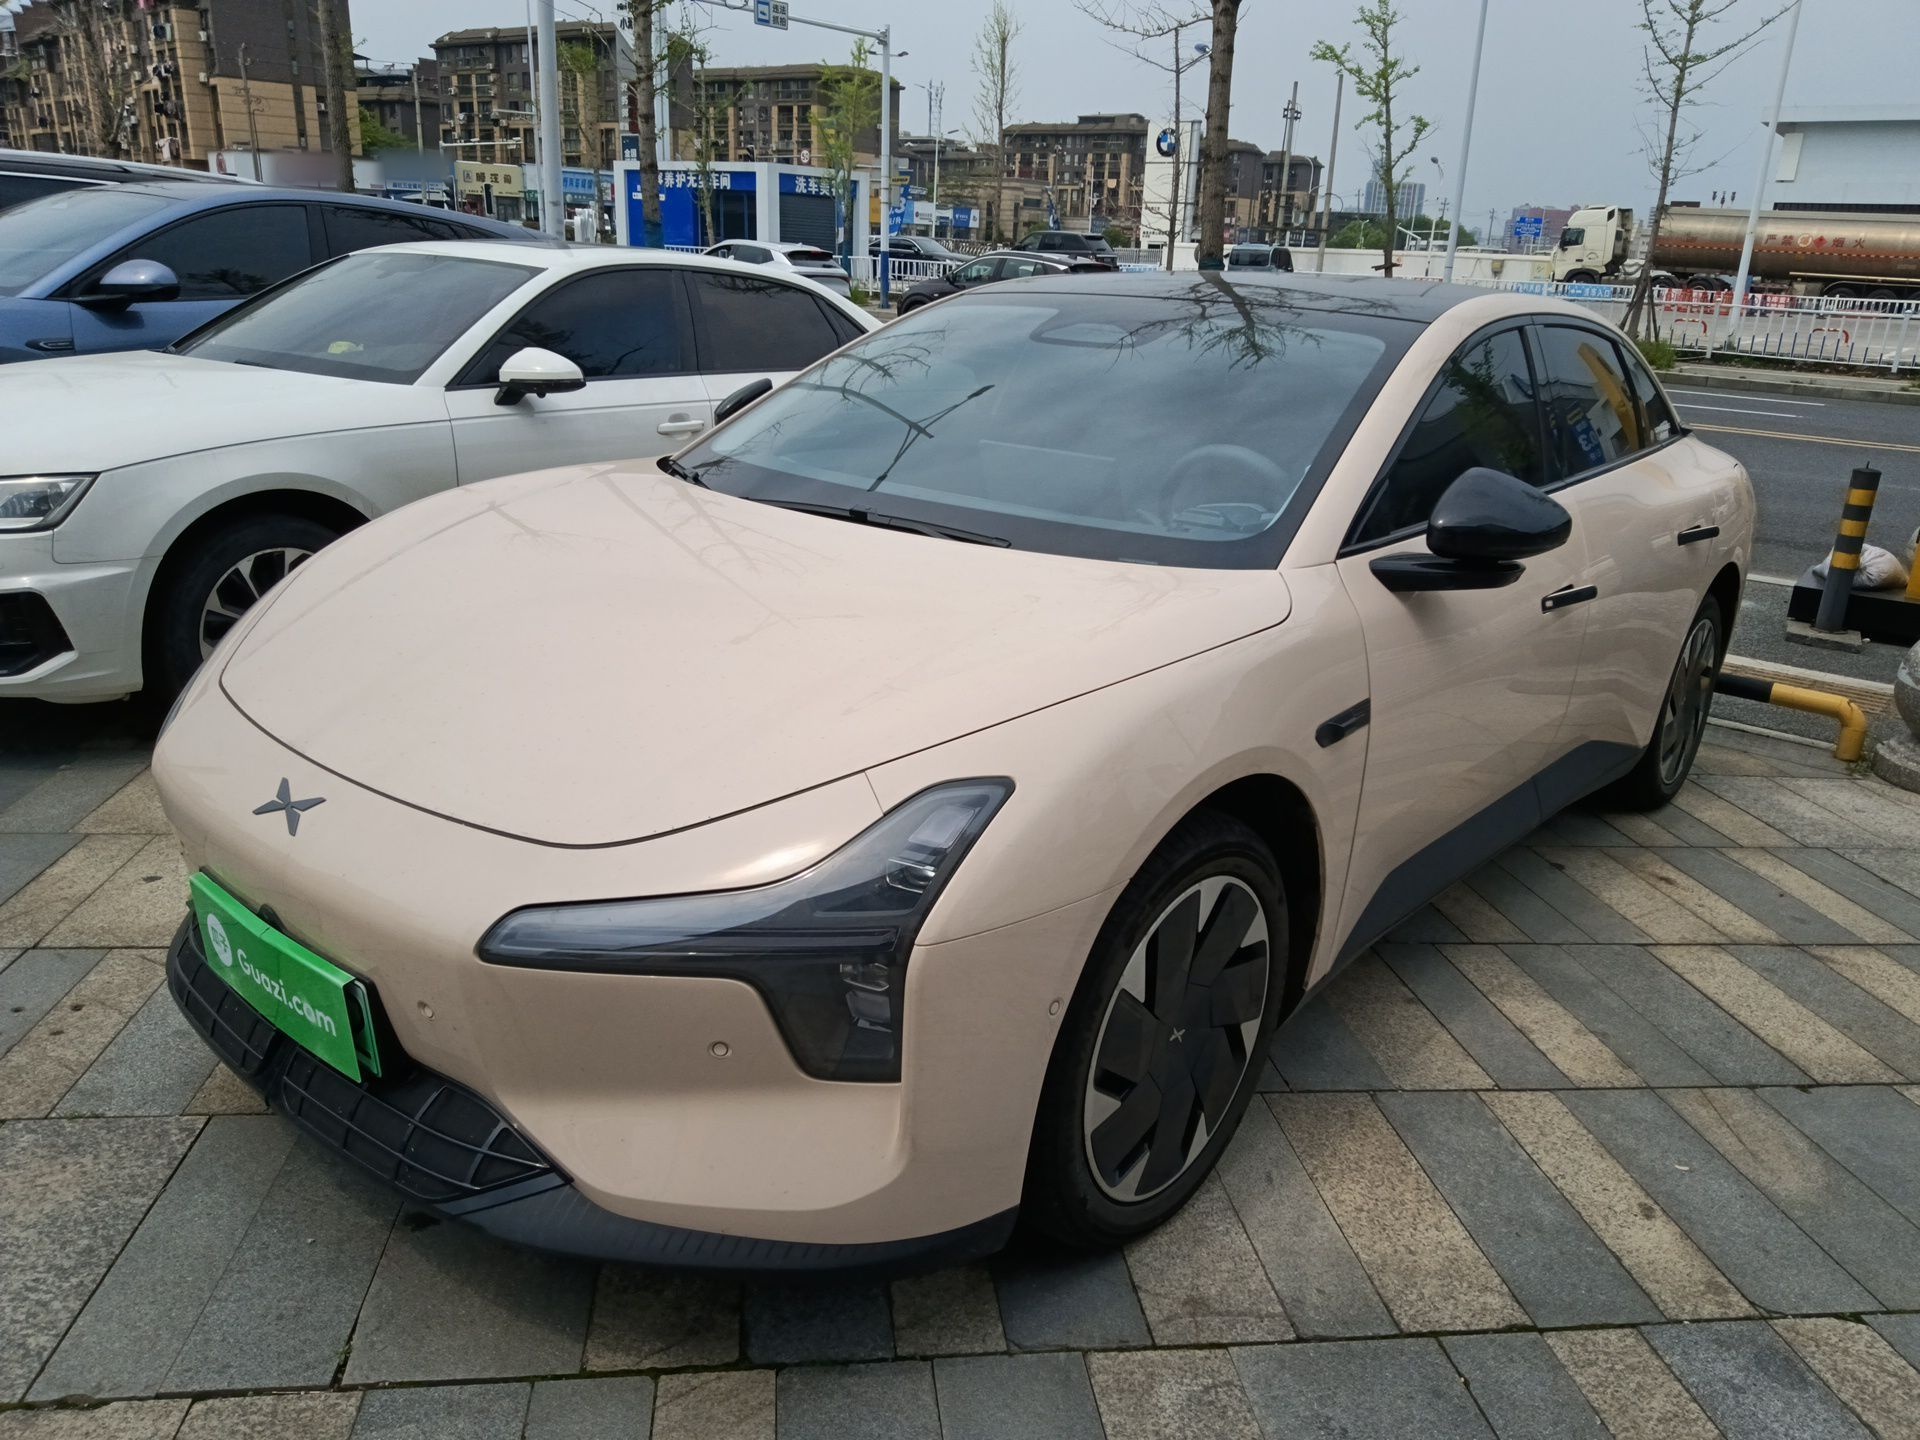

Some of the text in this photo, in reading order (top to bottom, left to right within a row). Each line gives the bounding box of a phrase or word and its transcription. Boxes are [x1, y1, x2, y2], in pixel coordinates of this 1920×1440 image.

[772, 3, 787, 15] 违法
[1764, 234, 1866, 249] 严禁 烟火
[237, 948, 337, 1038] Guazi.com
